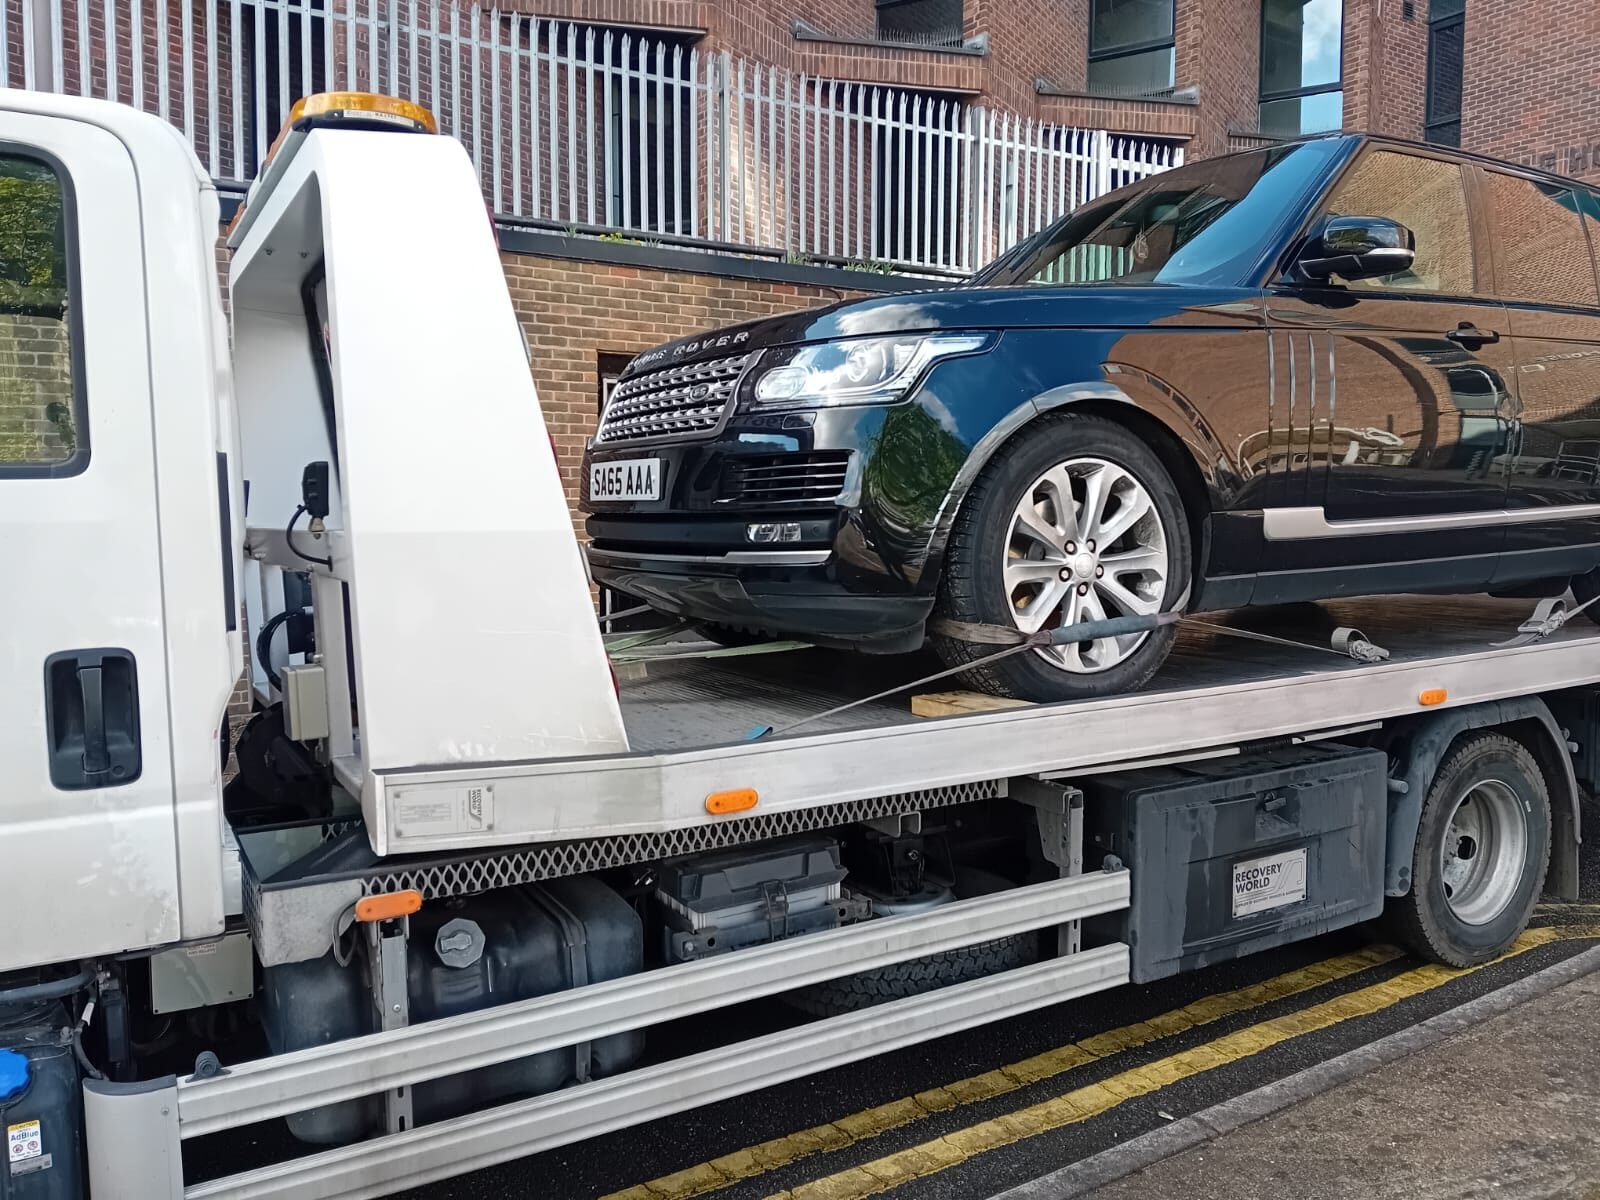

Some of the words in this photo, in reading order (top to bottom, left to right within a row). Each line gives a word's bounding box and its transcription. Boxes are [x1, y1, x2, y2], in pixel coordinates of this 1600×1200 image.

[673, 331, 749, 356] ROVER
[594, 467, 622, 496] SA65
[626, 465, 653, 495] AAA
[1235, 863, 1283, 883] RECOVERY
[1235, 877, 1270, 894] WORLD
[10, 1130, 39, 1142] AdBlue
